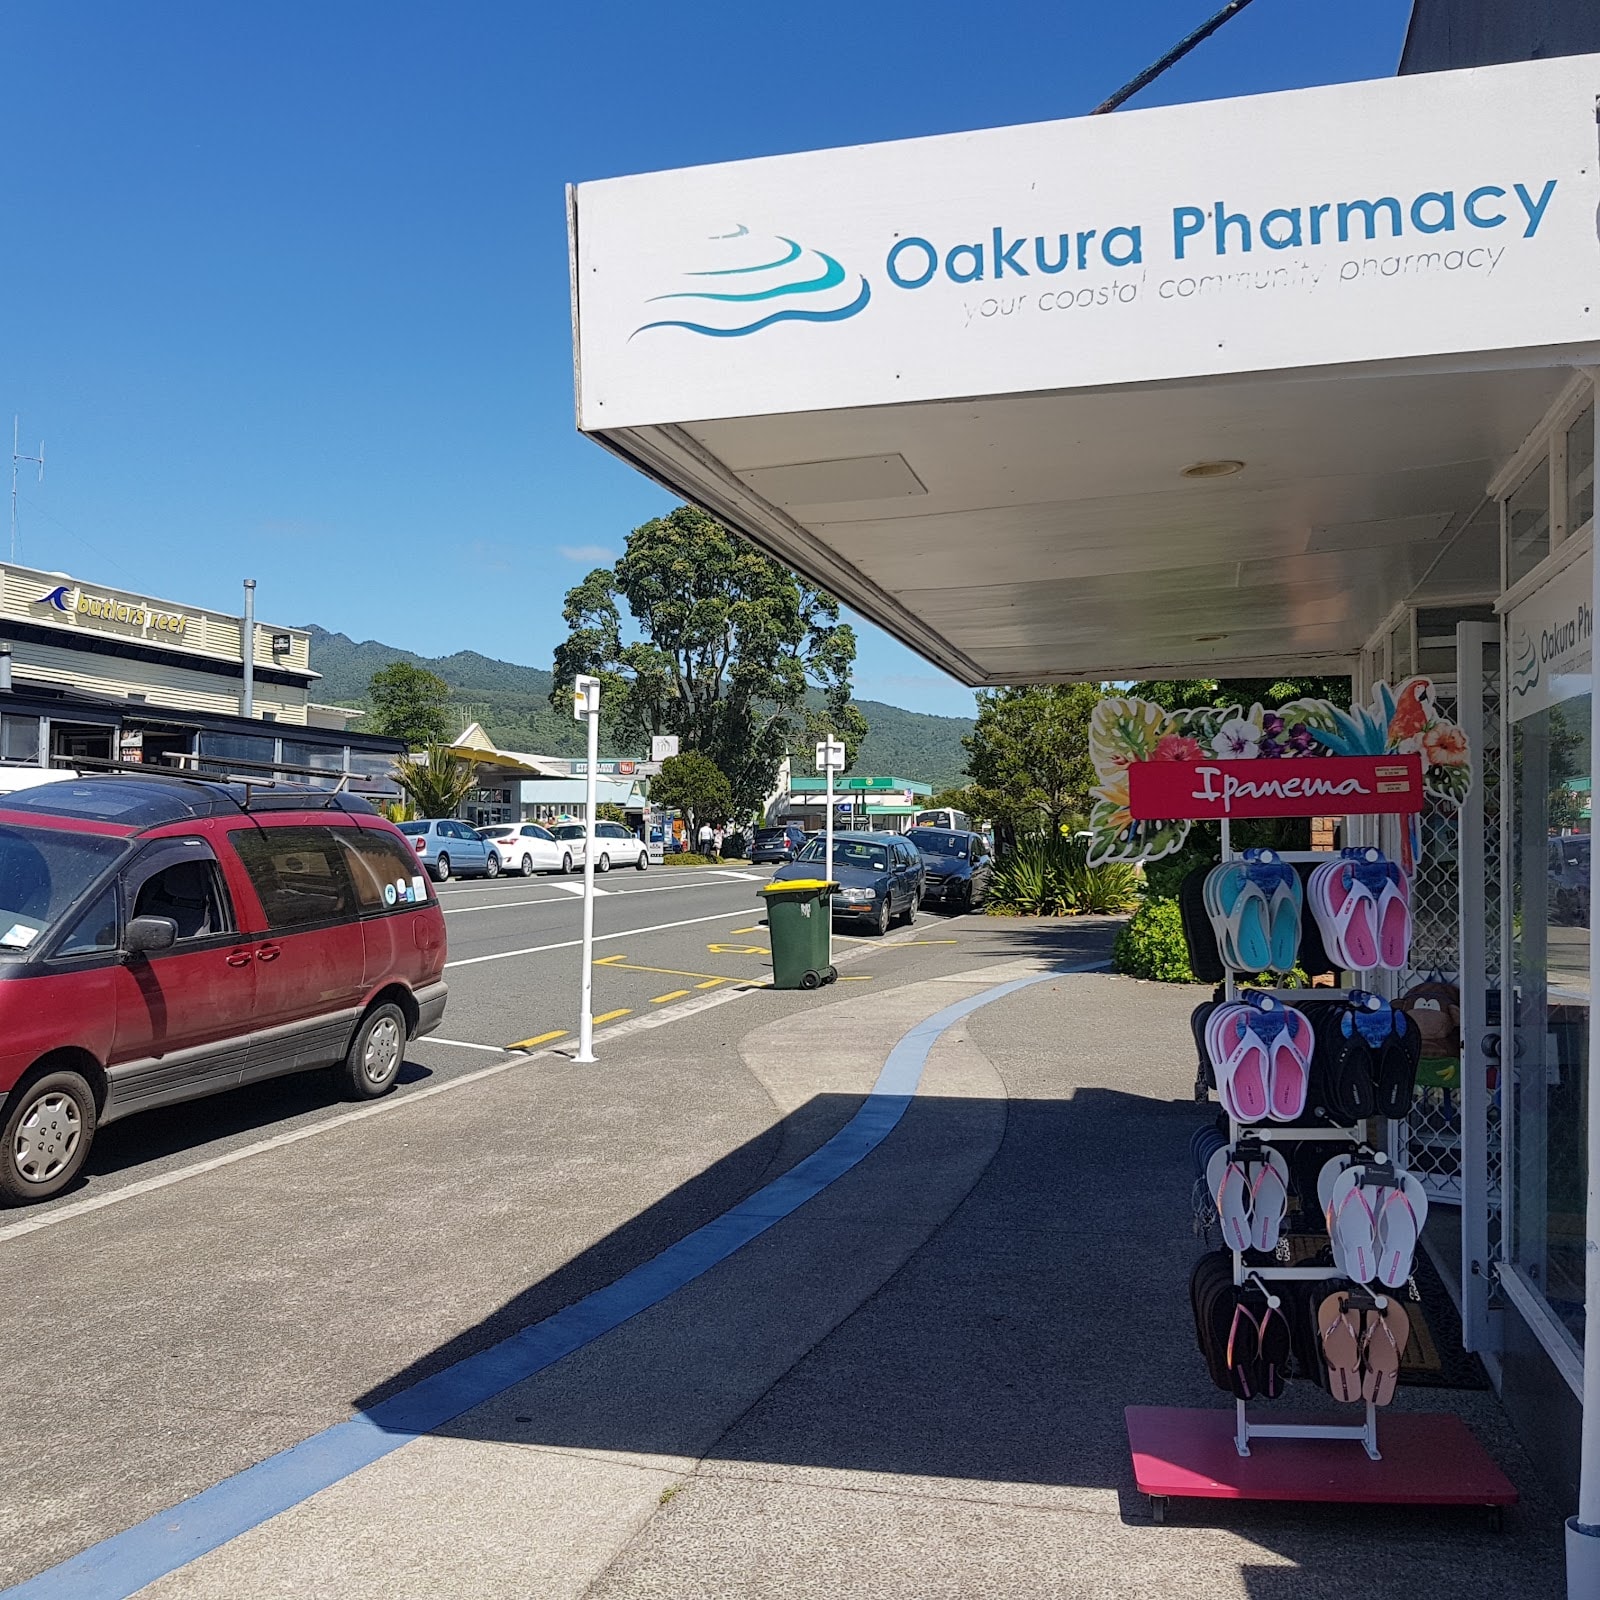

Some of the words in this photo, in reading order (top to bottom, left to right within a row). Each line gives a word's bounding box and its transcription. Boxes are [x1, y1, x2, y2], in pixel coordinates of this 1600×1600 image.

[887, 227, 1142, 289] Oakura
[1174, 181, 1556, 260] Pharmacy
[1038, 269, 1147, 311] coastal
[1159, 258, 1327, 299] comun
[77, 593, 145, 626] butlers
[150, 613, 187, 634] reef
[1541, 619, 1575, 664] Oakura
[1192, 766, 1371, 812] Ipanema
